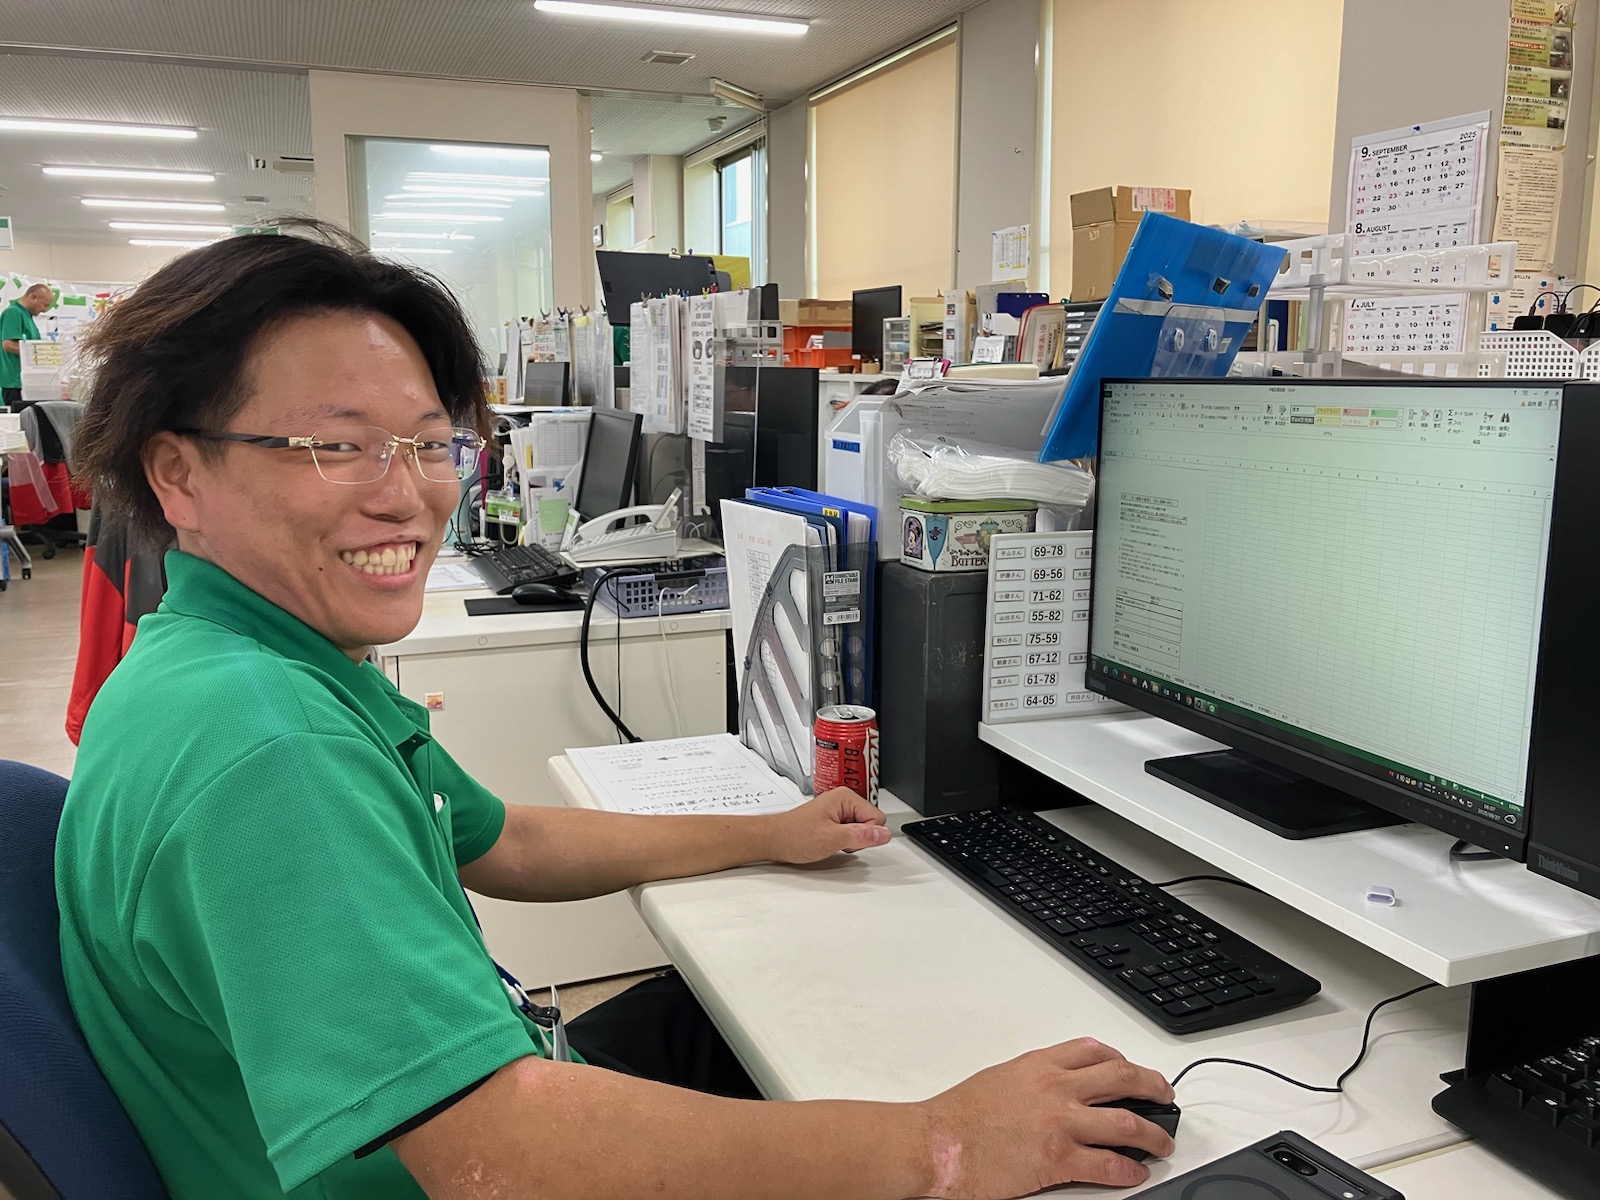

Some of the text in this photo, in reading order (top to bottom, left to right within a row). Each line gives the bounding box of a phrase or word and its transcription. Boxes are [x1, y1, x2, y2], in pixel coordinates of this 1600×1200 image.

[1459, 131, 1477, 140] 2025
[1372, 144, 1408, 155] SEPTEMBER
[1355, 222, 1391, 234] 8. AUGUST
[1034, 545, 1063, 557] 69-78
[1033, 569, 1063, 580] 69-56
[1033, 590, 1061, 602] 71-62
[1032, 610, 1061, 621] 55-82
[1029, 634, 1058, 644] 75-59
[1029, 653, 1058, 664] 67-12
[1027, 674, 1056, 684] 61-78
[1026, 695, 1055, 706] 64-05
[844, 748, 859, 792] BLAC
